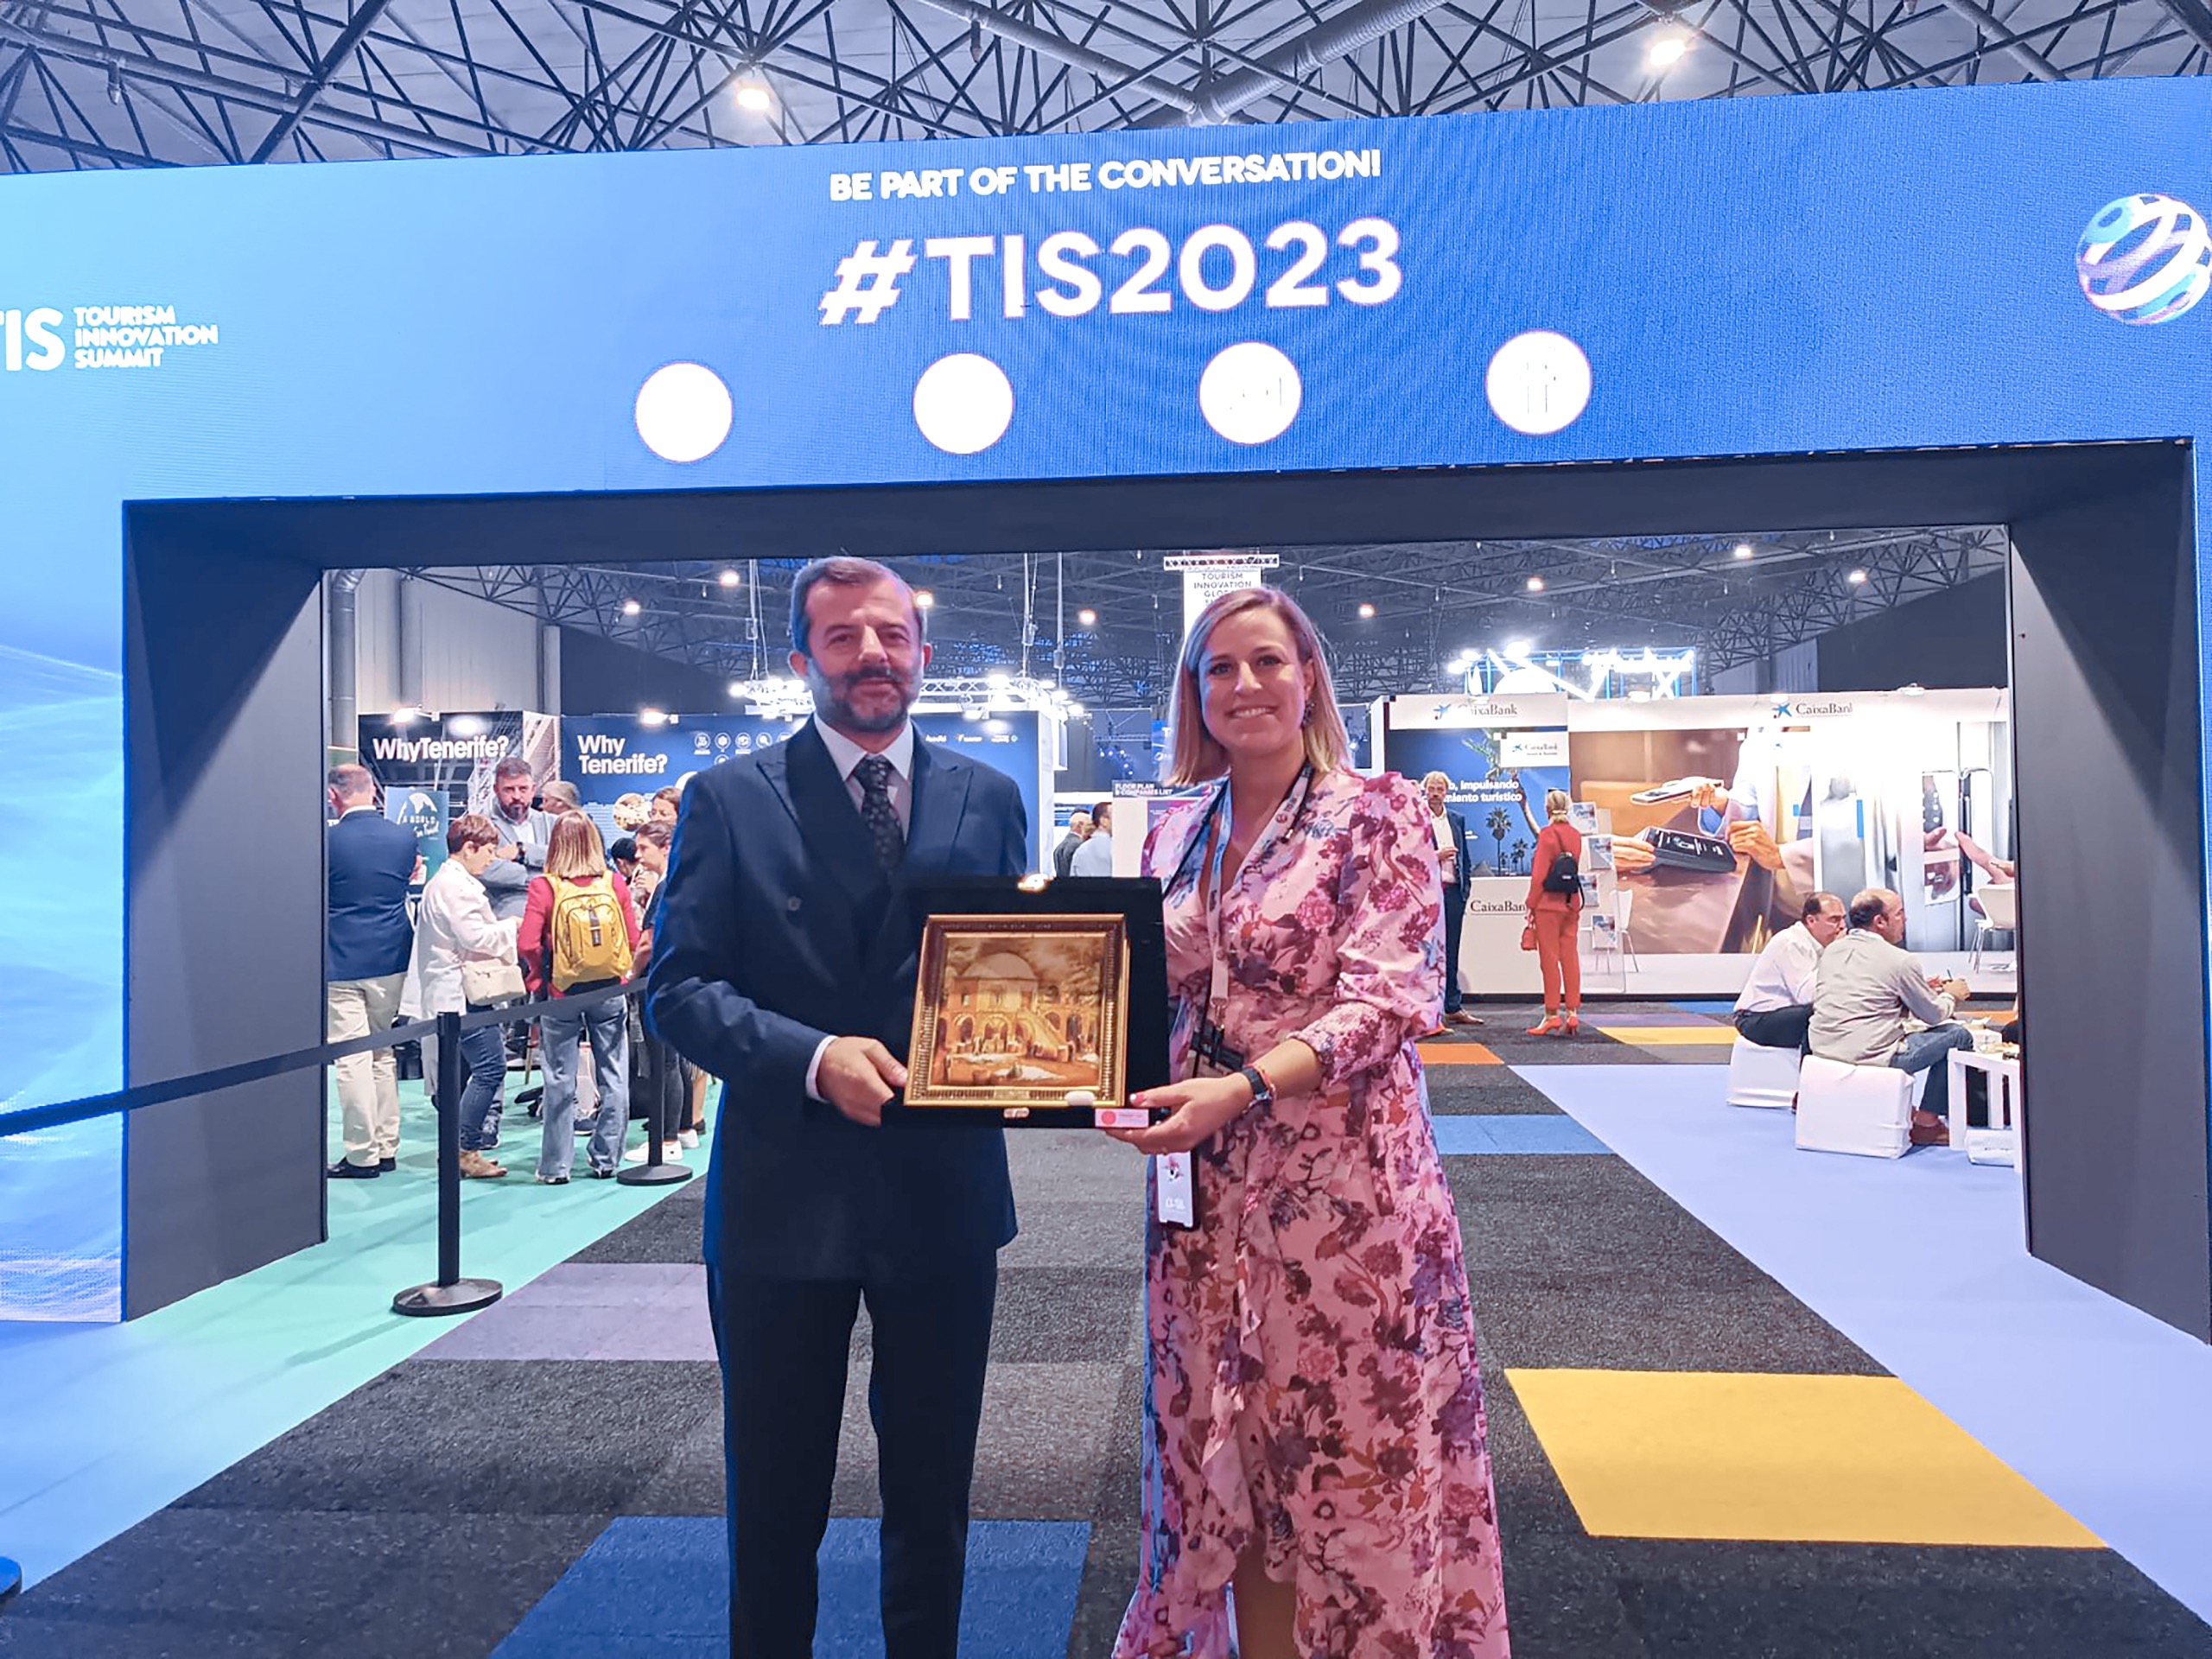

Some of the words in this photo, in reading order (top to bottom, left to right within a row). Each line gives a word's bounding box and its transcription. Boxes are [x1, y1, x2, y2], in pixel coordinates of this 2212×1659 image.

[830, 172, 874, 201] BE
[880, 168, 964, 199] PART
[969, 166, 1017, 194] OF
[1023, 162, 1092, 192] THE
[1098, 149, 1382, 189] CONVERSATION!
[818, 216, 1402, 326] #TIS2023
[73, 305, 176, 327] TOURISM
[0, 307, 66, 372] IS
[74, 324, 219, 347] INNOVATION
[74, 347, 164, 369] SUMMIT
[1193, 581, 1252, 589] INNOVATION
[1201, 572, 1243, 581] TOURISM
[577, 734, 626, 756] Why
[578, 753, 668, 775] Tenerife?
[1471, 899, 1526, 912] CaixaBan
